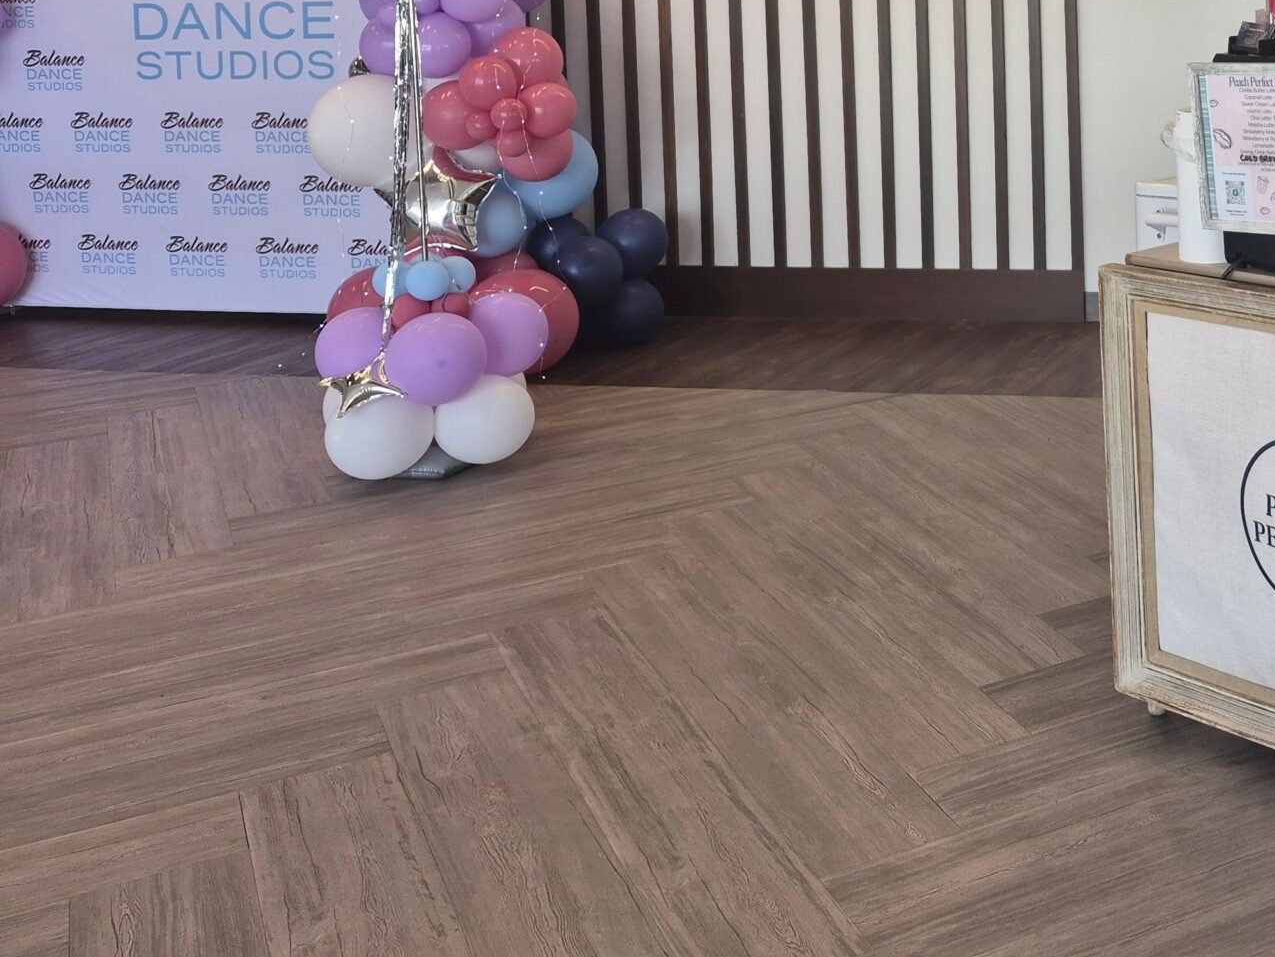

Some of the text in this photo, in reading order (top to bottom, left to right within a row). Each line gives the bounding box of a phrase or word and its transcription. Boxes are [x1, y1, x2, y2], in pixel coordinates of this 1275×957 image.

[133, 1, 335, 40] DANCE
[23, 49, 85, 67] Balance
[136, 50, 335, 80] STUDIOS
[26, 69, 83, 80] DANCE
[27, 82, 83, 91] STUDIOS
[1229, 76, 1249, 87] Peach
[1250, 76, 1273, 87] Perfect
[0, 111, 43, 128] alance
[70, 111, 133, 129] Balance
[160, 111, 224, 129] Balance
[251, 111, 308, 130] Balanc
[0, 130, 40, 141] ANCE
[74, 130, 130, 142] DANCE
[164, 131, 221, 142] DANCE
[0, 143, 41, 152] UDIOS
[75, 144, 131, 153] STUDIOS
[165, 144, 221, 153] STUDIOS
[29, 173, 92, 190] Balance
[118, 173, 181, 191] Balance
[208, 174, 272, 192] Balance
[33, 192, 89, 203] DANCE
[122, 193, 178, 204] DANCE
[211, 193, 268, 205] DANCE
[303, 194, 360, 206] DANCE
[34, 205, 89, 213] STUDIOS
[123, 205, 178, 215] STUDIOS
[212, 206, 269, 216] STUDIOS
[304, 207, 360, 218] STUDIOS
[78, 234, 139, 251] Balance
[165, 236, 228, 253] Balance
[255, 237, 319, 254] Balance
[347, 239, 389, 256] Bala
[81, 253, 136, 264] DANCE
[169, 254, 225, 266] DANCE
[259, 256, 316, 268] DANCE
[82, 266, 136, 275] STUDIOS
[170, 268, 225, 278] STUDIOS
[260, 269, 317, 279] STUDIOS
